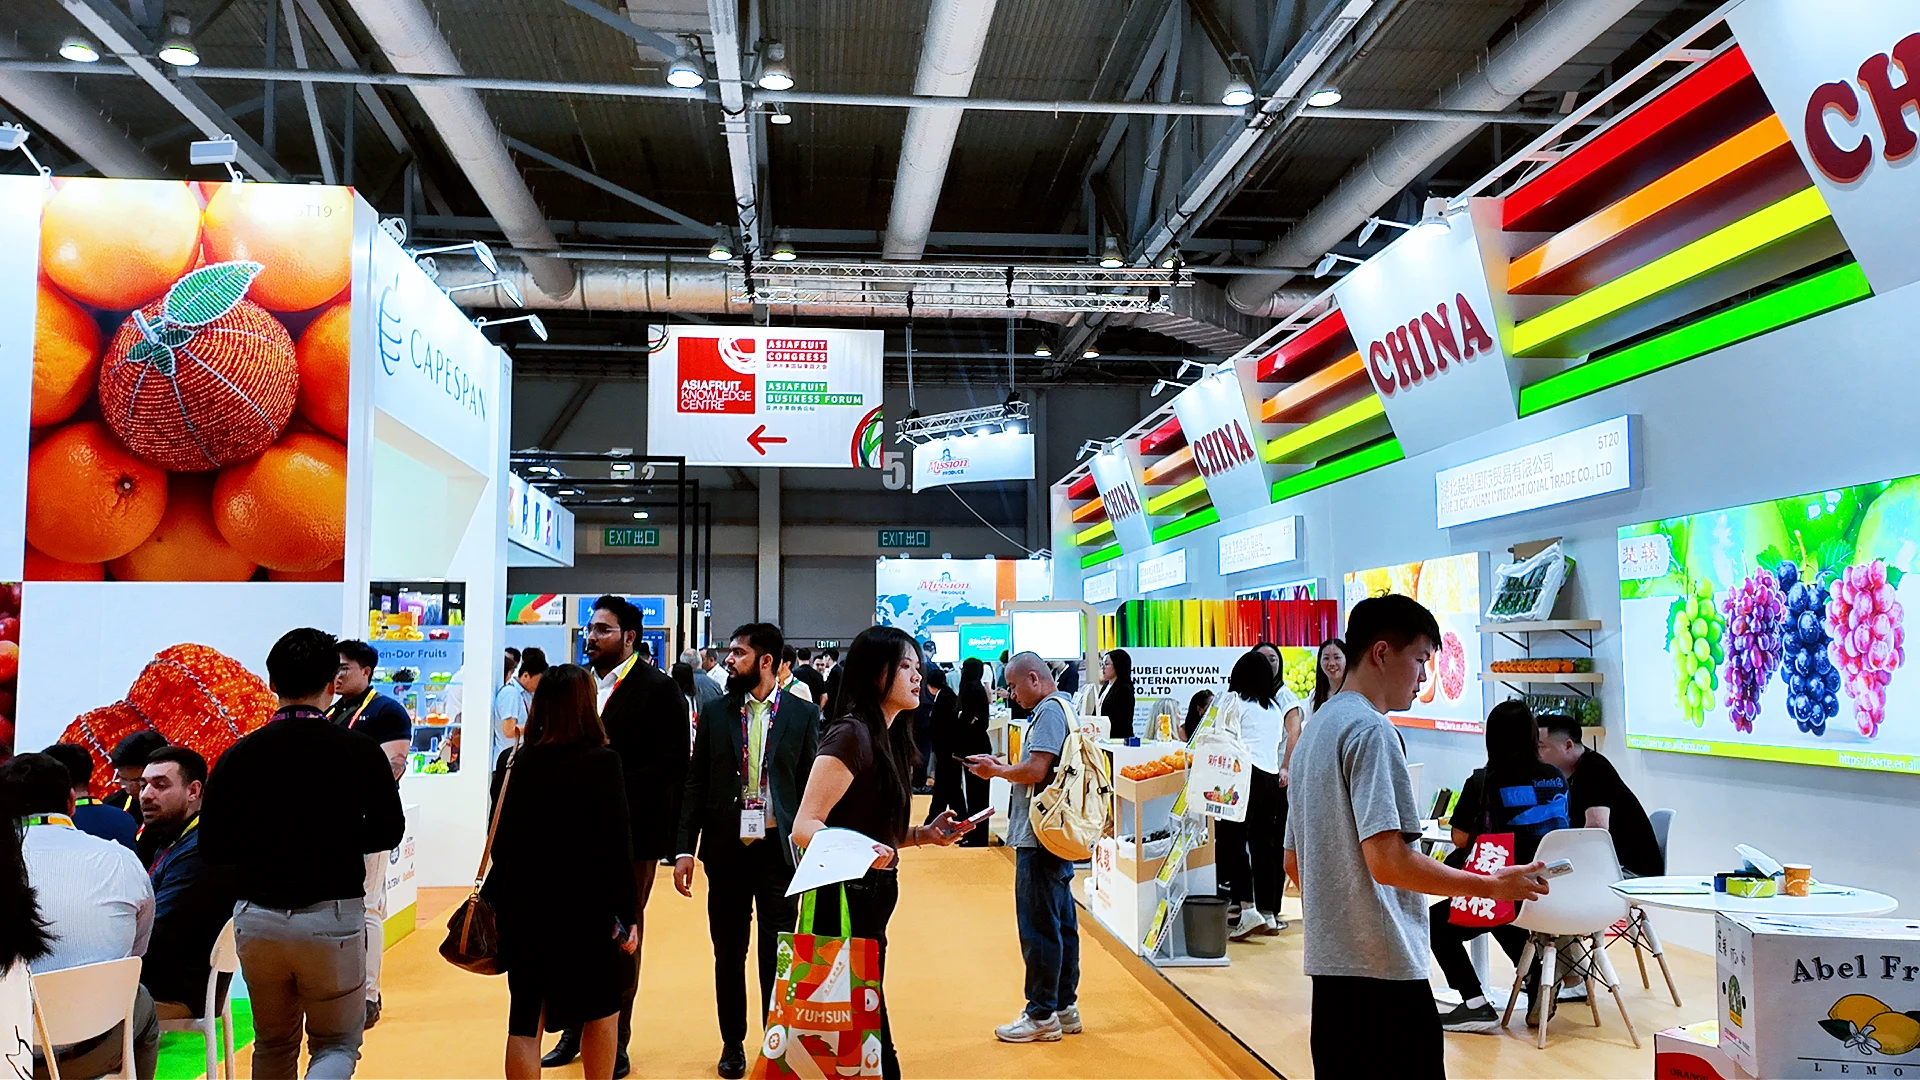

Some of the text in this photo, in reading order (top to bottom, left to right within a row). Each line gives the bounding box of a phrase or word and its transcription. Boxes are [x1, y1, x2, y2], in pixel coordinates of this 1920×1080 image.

[767, 340, 826, 349] ASIAFRUIT
[1370, 293, 1492, 395] CHINA
[767, 352, 826, 361] CONGRESS
[410, 329, 486, 421] CAPESPAN
[681, 379, 741, 390] ASIAFRUIT
[767, 382, 826, 391] ASIAFRUIT
[681, 389, 751, 401] KNOWLEDGE
[767, 394, 862, 404] BUSINESS FORUM
[681, 400, 724, 410] CENTRE
[1598, 431, 1620, 450] 5T20
[1193, 419, 1255, 478] CHINA
[928, 459, 969, 474] Mission
[1440, 461, 1612, 515] HUBEI CHUYUAN INTERNATIONAL TRADE CO., LTD
[1104, 481, 1141, 523] CHINA
[609, 529, 655, 545] EXIT 出口
[882, 531, 926, 546] EXIT 出口
[919, 580, 971, 592] Mission
[417, 649, 447, 658] Fruits
[1130, 666, 1220, 675] HUBEI CHUYUAN
[1132, 676, 1218, 685] NTERNATIONAL
[1791, 954, 1920, 984] Abel Fr
[795, 1007, 852, 1024] YUMSUN
